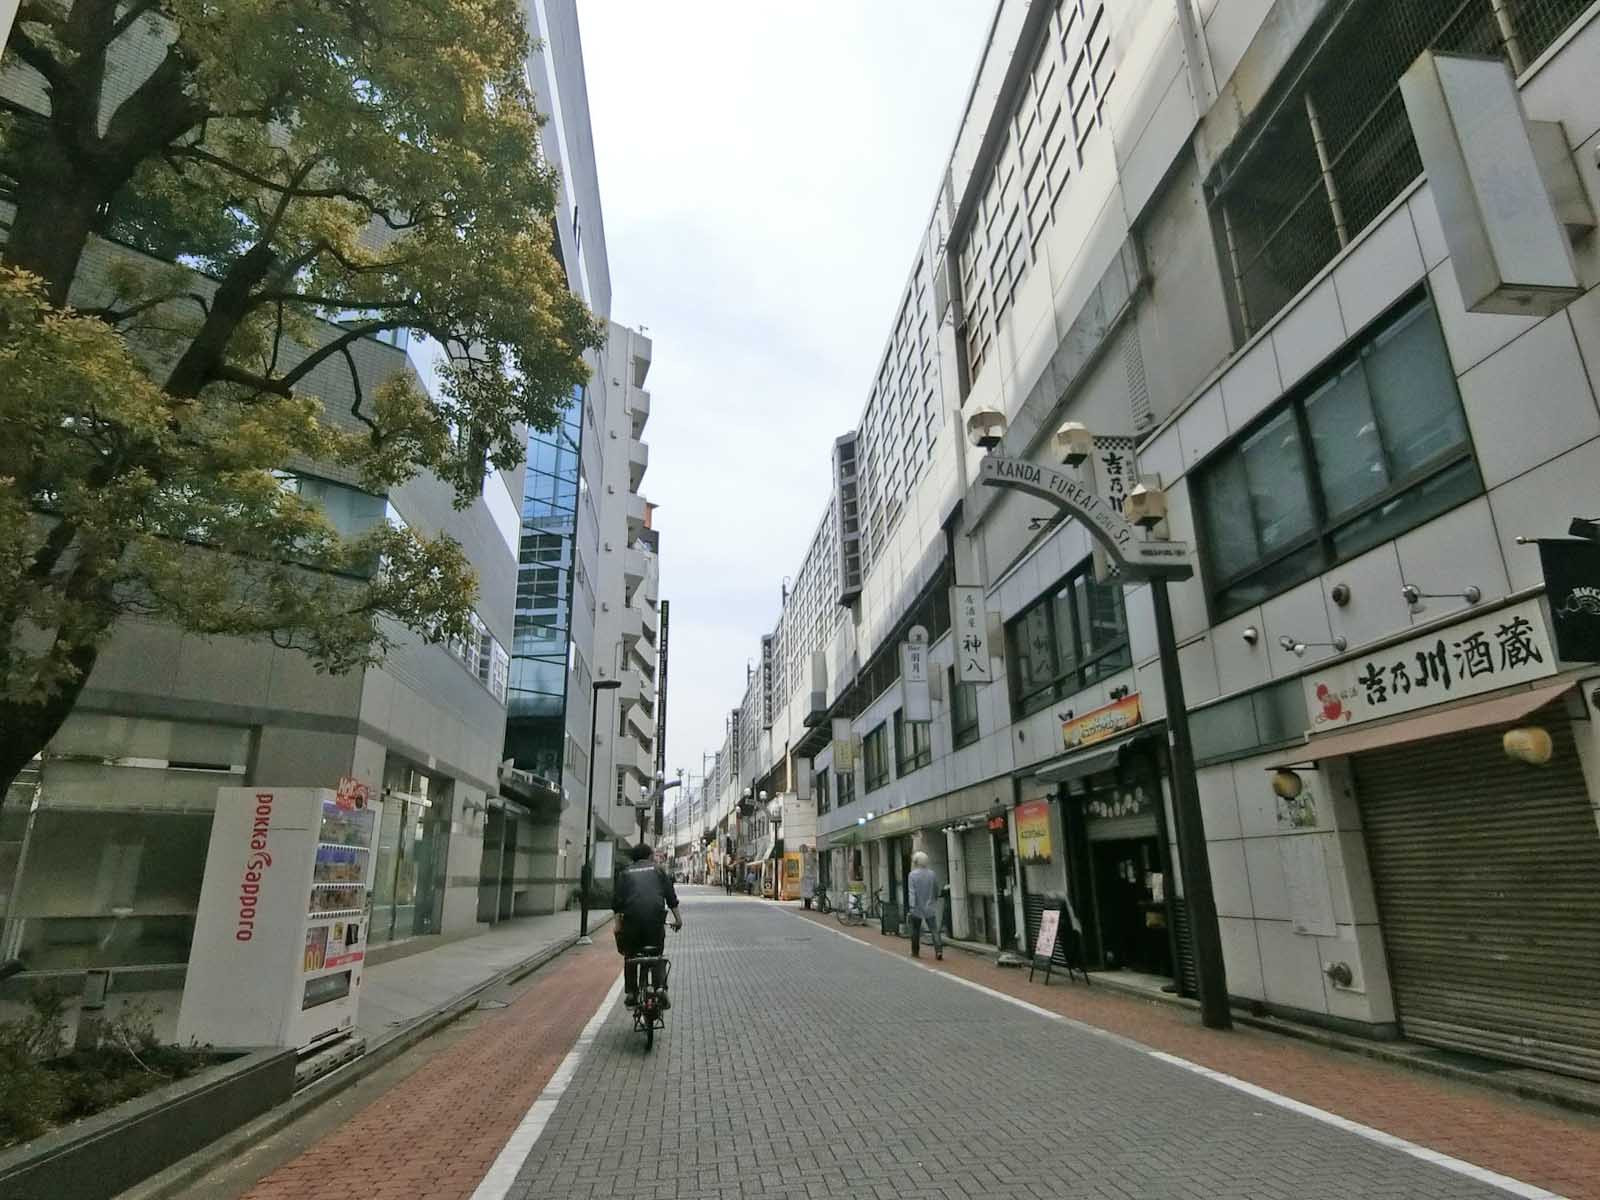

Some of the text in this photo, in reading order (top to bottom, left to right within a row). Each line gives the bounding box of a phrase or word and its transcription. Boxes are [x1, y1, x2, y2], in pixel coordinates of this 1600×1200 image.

[996, 460, 1041, 485] KANDA
[1049, 475, 1098, 512] FUREAI
[962, 634, 985, 673] 神八
[1358, 616, 1543, 705] 吉乃川酒蔵
